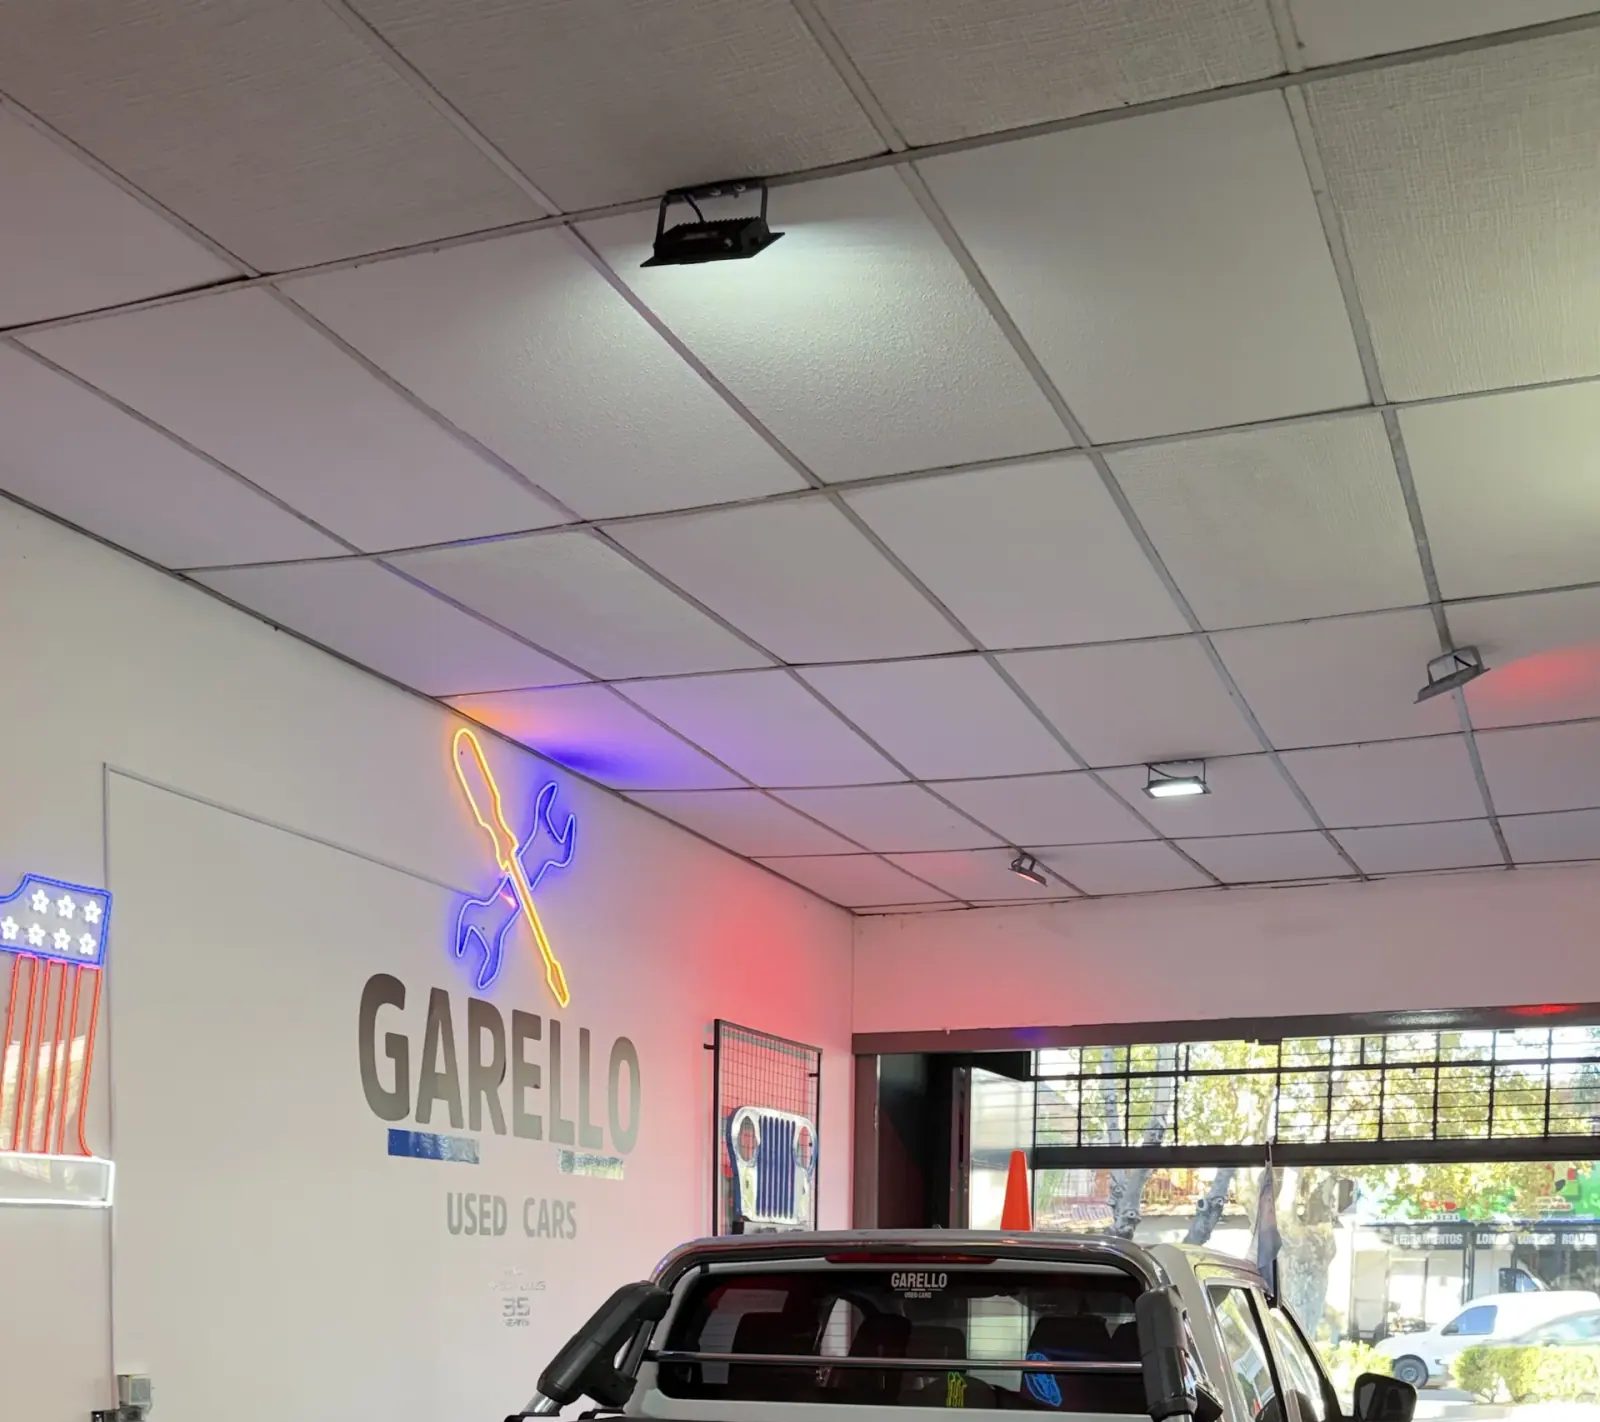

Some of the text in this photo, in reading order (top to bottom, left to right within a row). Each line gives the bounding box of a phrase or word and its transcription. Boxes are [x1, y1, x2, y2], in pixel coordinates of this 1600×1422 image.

[358, 973, 641, 1155] GARELLO
[446, 1192, 577, 1239] USED CARS
[891, 1272, 947, 1288] GARELLO
